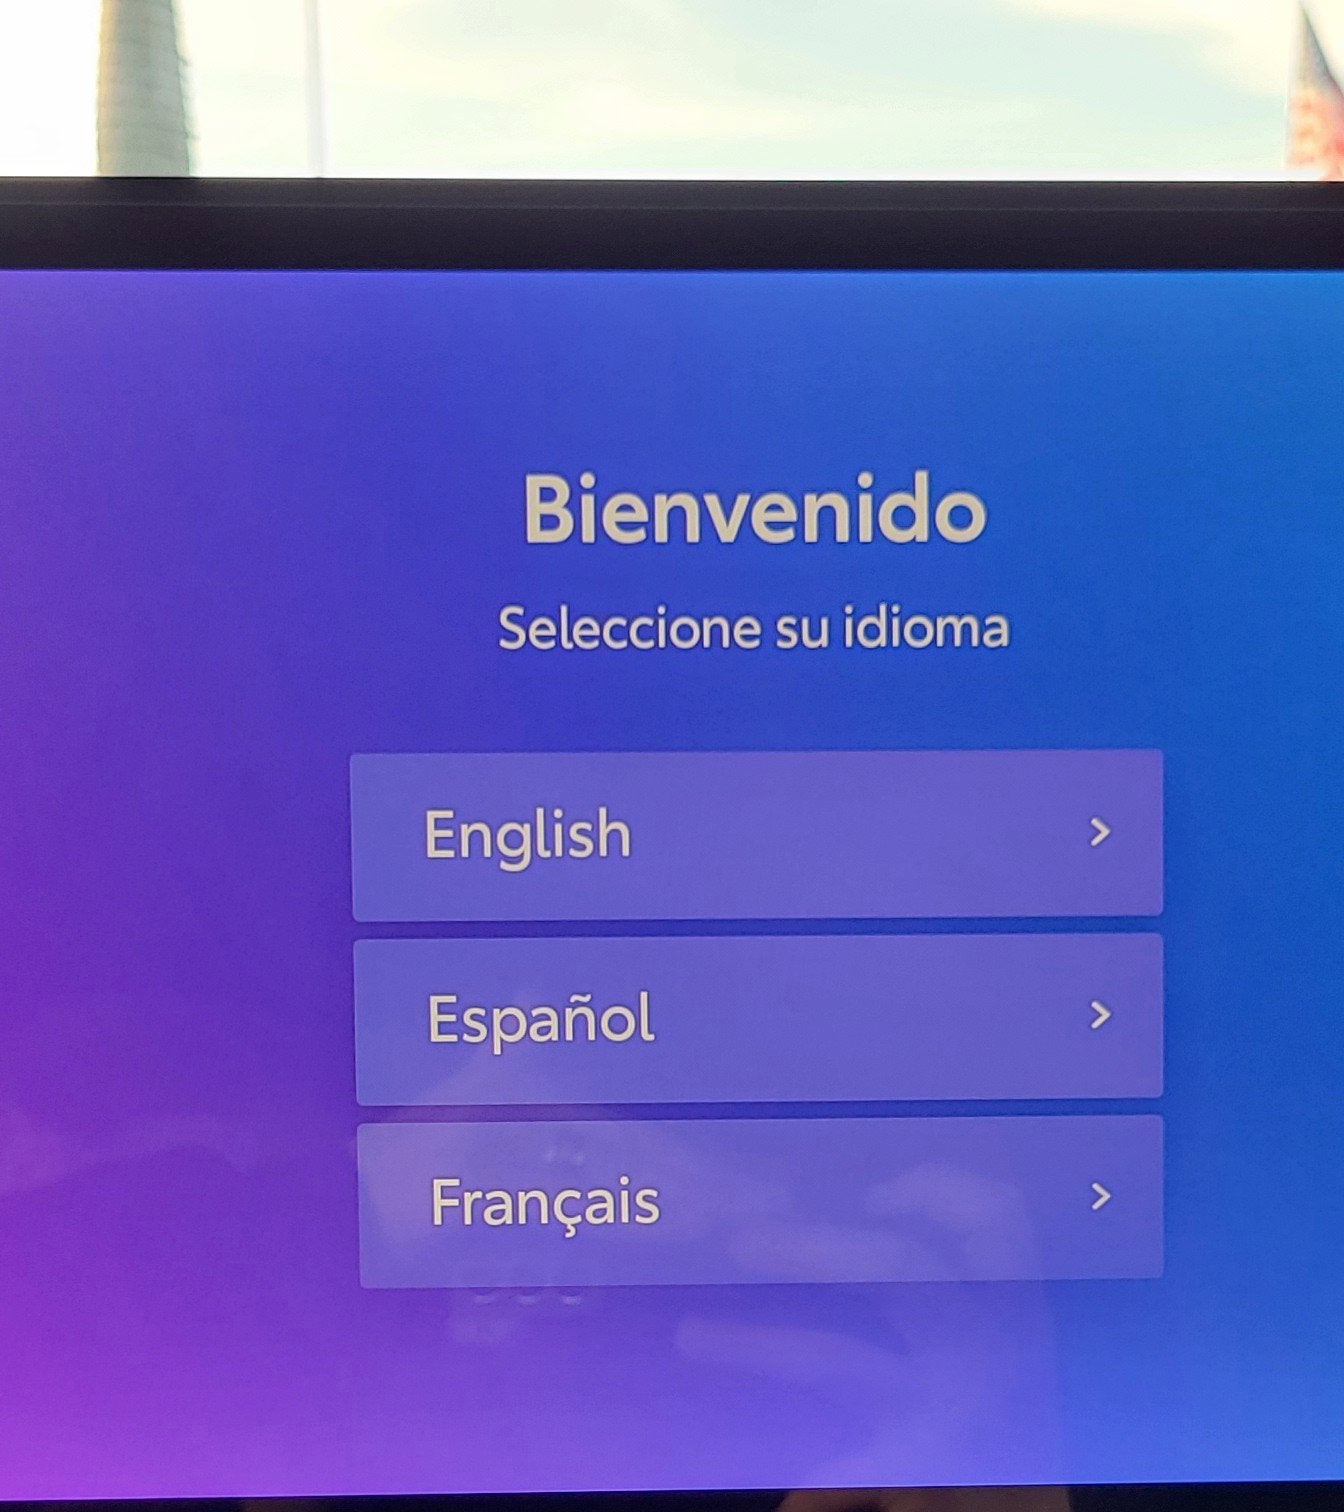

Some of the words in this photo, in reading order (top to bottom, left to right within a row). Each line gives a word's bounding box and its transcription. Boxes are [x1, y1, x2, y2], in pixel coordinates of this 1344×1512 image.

[523, 470, 989, 545] Bienvenido
[498, 604, 762, 650] Seleccione
[775, 611, 829, 650] su
[843, 601, 1010, 649] idioma
[424, 808, 633, 873] English
[426, 990, 656, 1055] Español
[432, 1175, 661, 1239] Français
